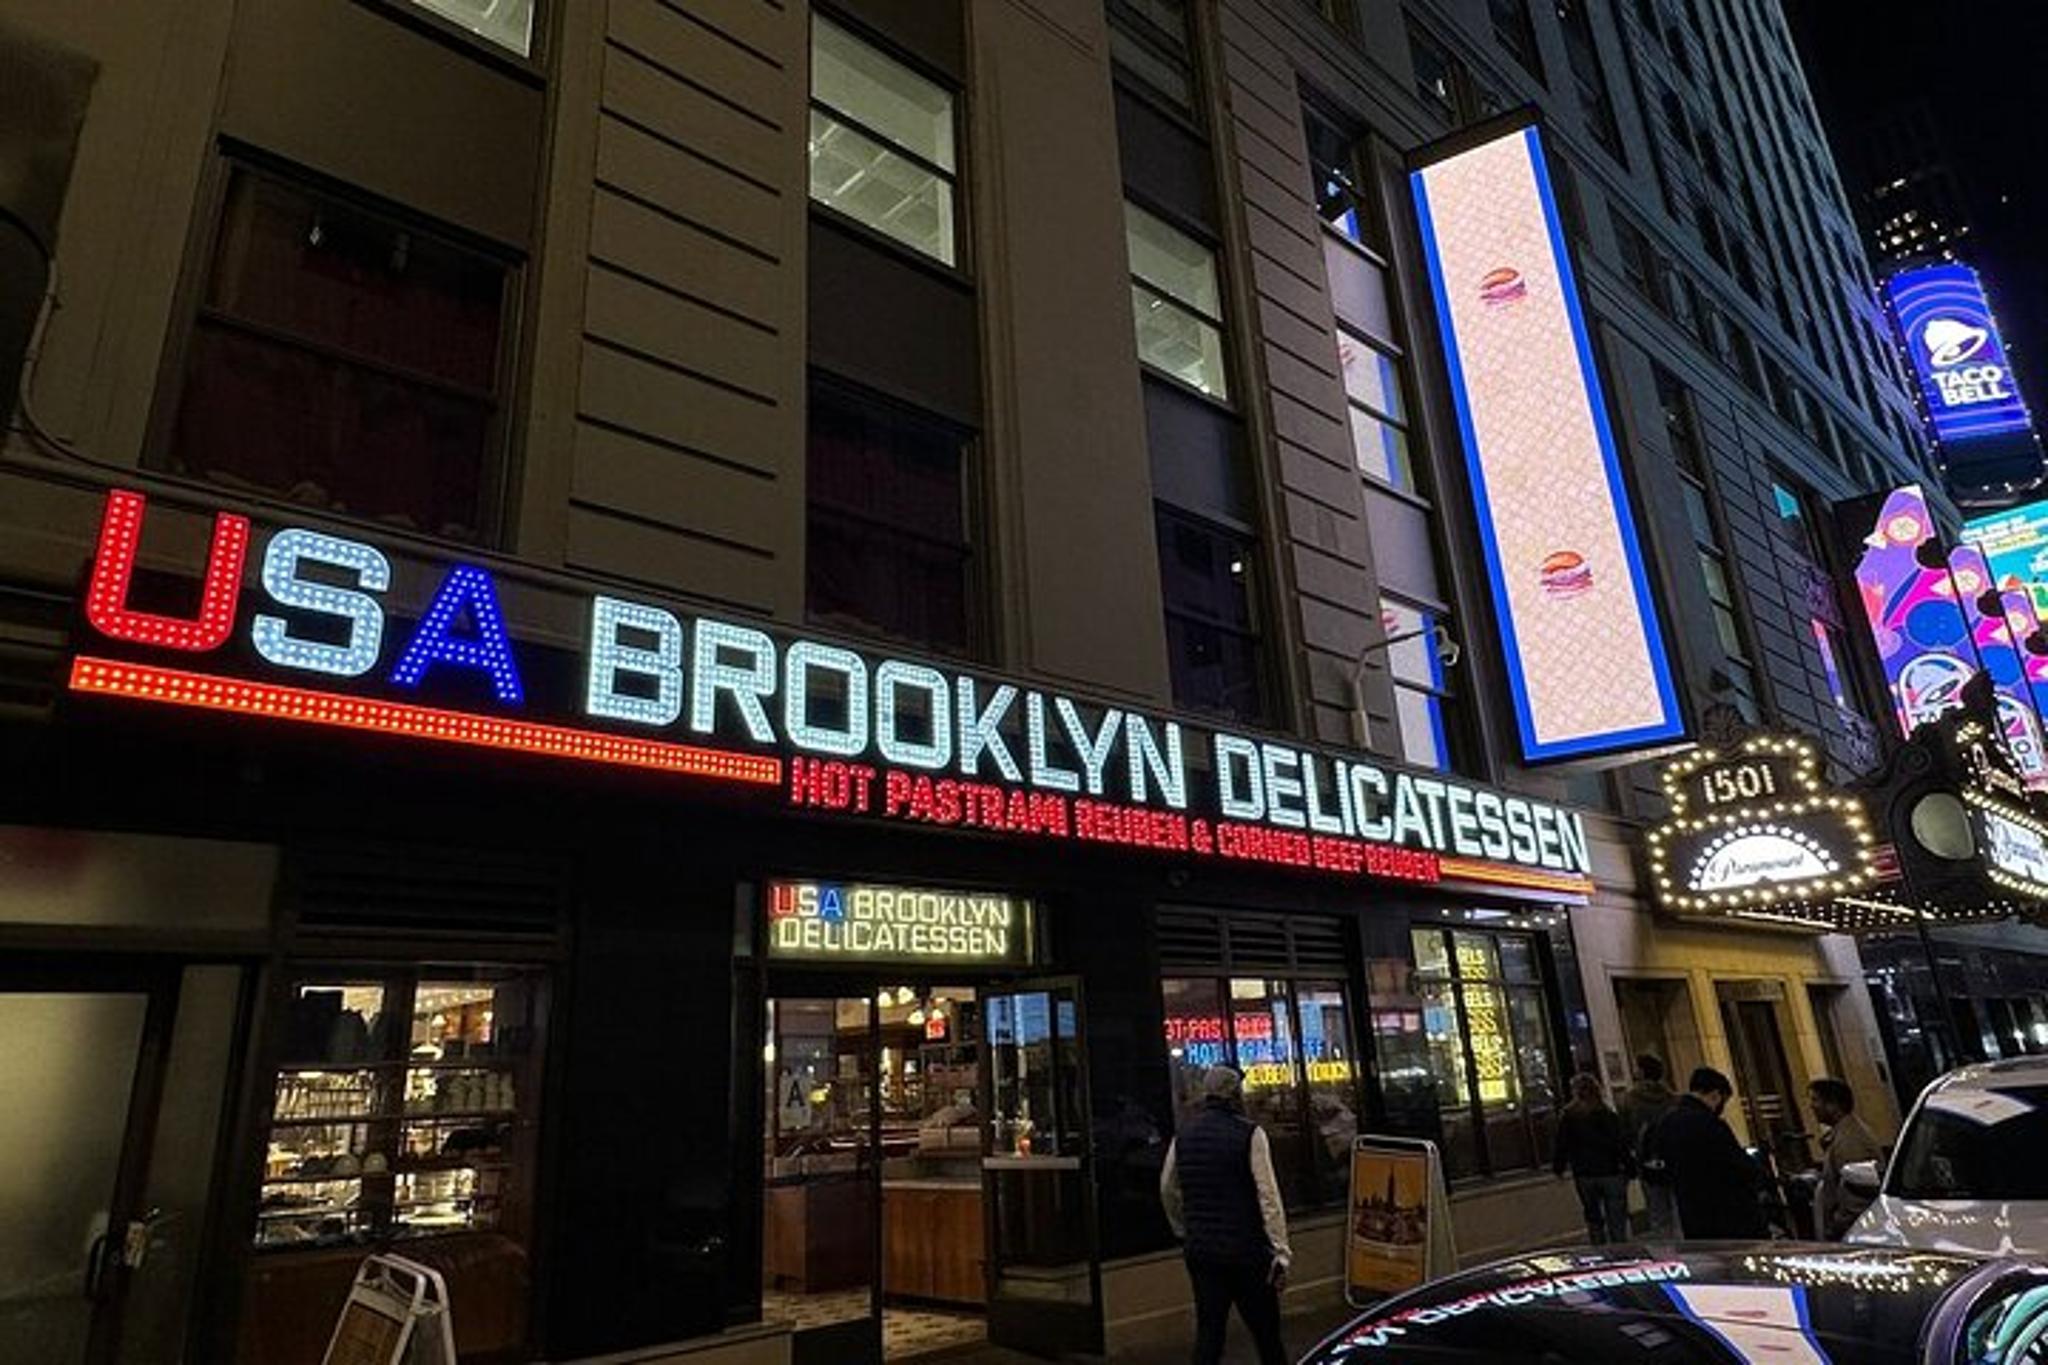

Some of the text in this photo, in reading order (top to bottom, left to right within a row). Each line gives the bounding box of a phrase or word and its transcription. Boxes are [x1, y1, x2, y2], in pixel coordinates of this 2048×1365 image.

[1931, 365, 2003, 389] TACO
[1940, 383, 2012, 406] BELL
[84, 488, 1592, 874] USA BROOKLYN DELICATESSEN
[1703, 764, 1775, 803] 1501
[791, 755, 1441, 883] HOT PASTRAMI REUBEN & CORNED BEEF REUBEN
[772, 885, 1011, 956] USA BROOKLYN DELICATESSEN
[785, 1079, 806, 1108] A
